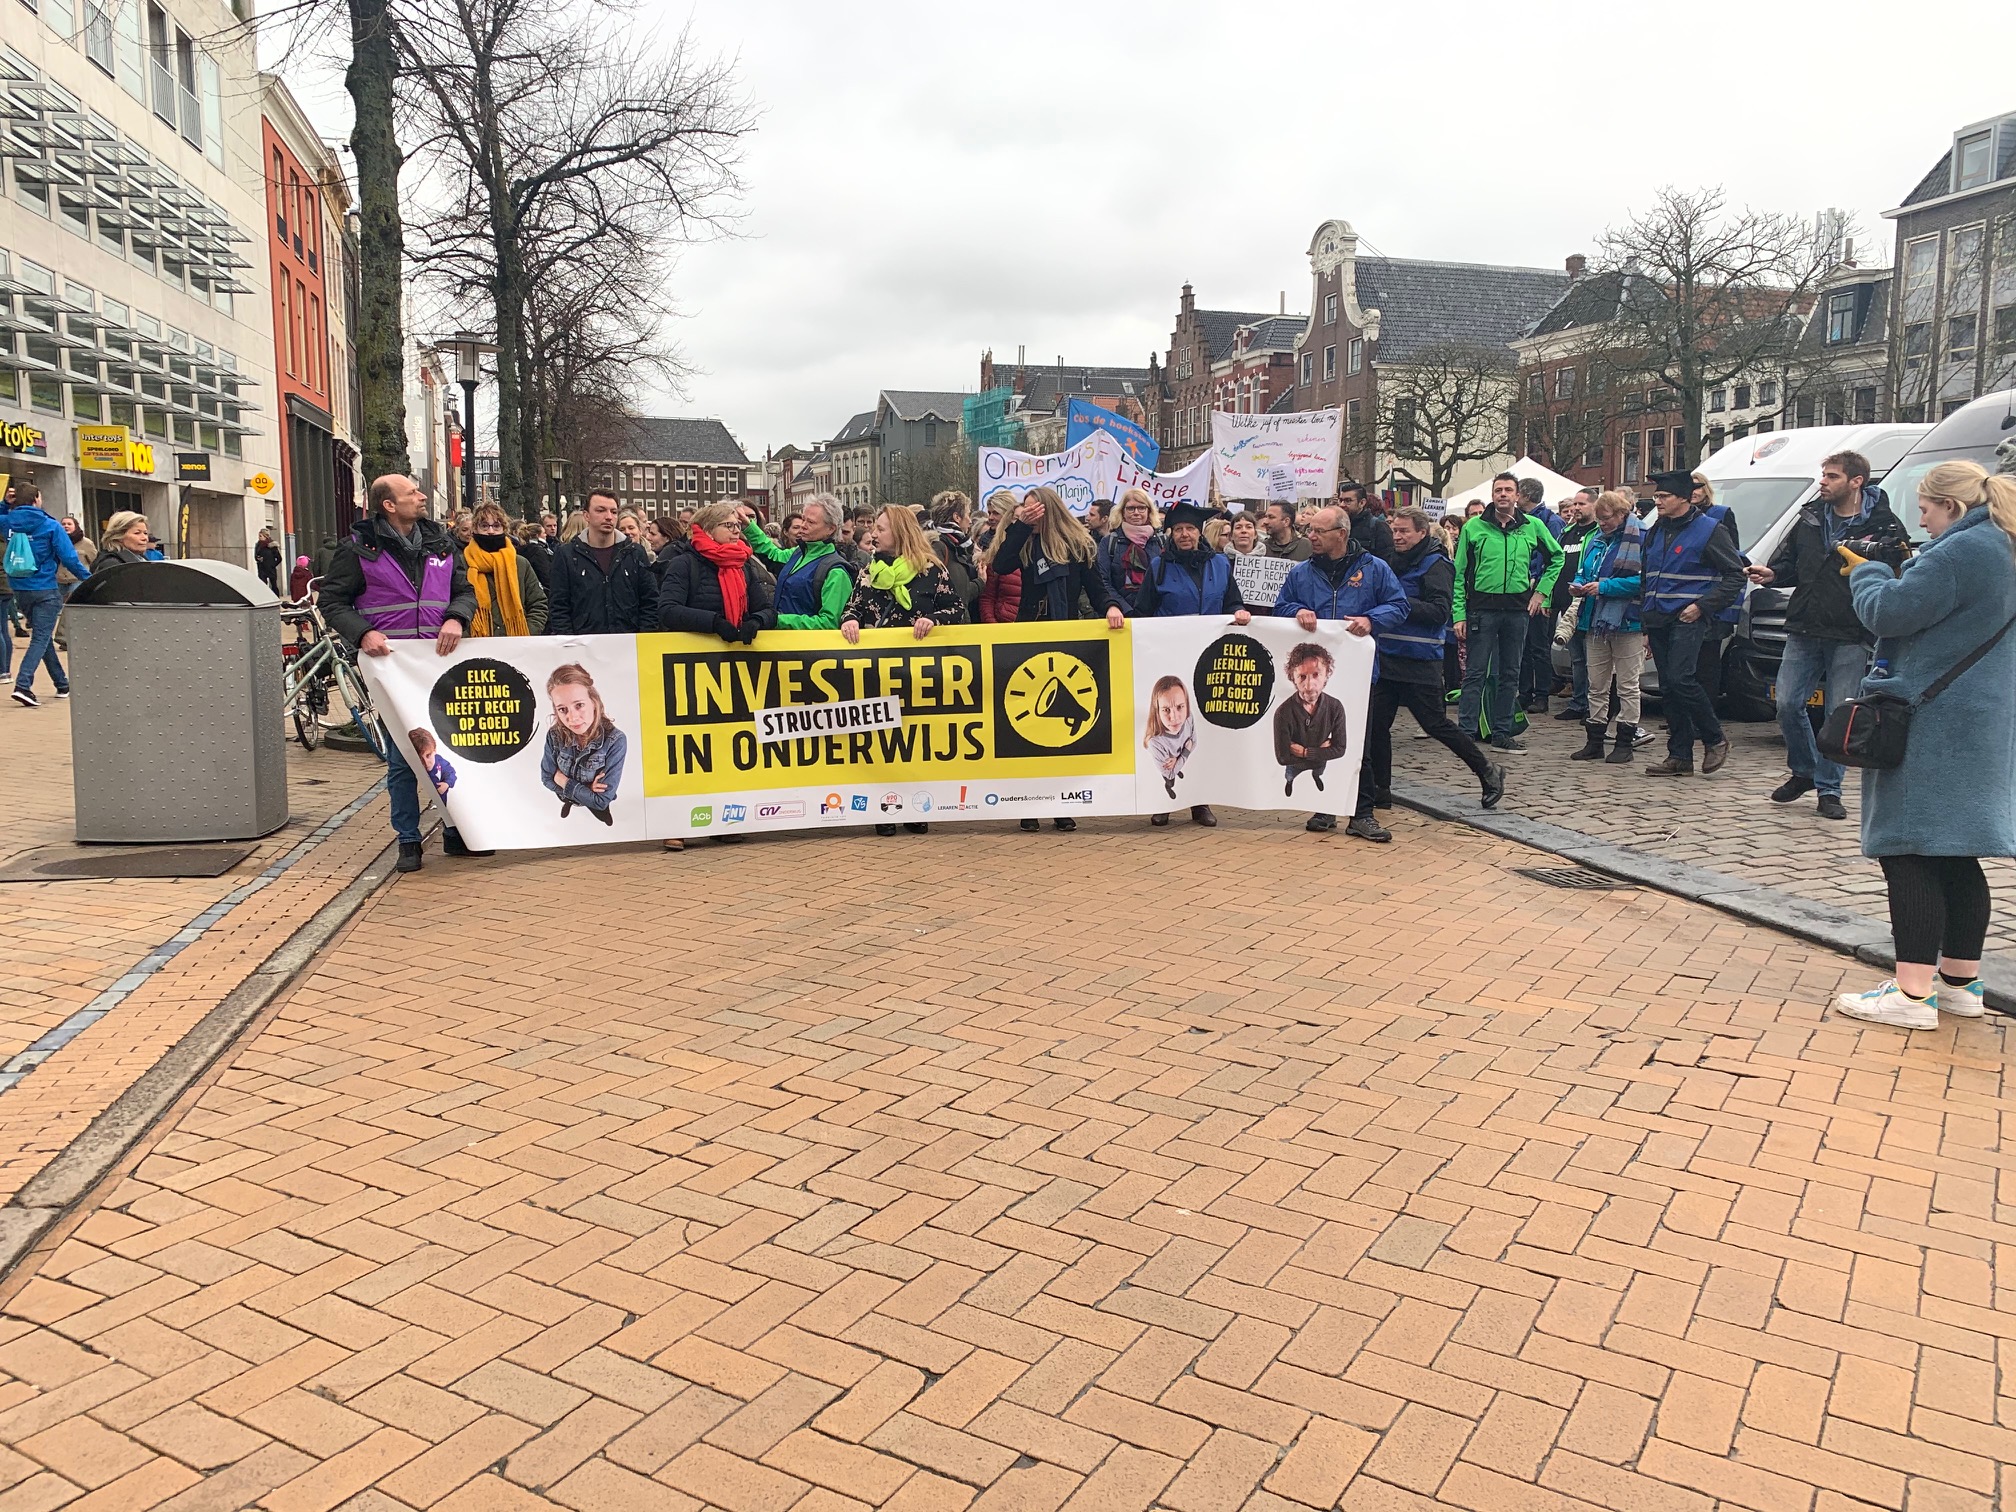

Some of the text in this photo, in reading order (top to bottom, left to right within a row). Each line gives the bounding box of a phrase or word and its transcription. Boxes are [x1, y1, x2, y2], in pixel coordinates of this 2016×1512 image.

[81, 433, 123, 443] Intertoys
[413, 416, 423, 453] Bershka
[129, 441, 154, 475] nos
[985, 442, 1094, 480] Onderwijs
[1116, 464, 1189, 499] Liefde
[1056, 484, 1089, 502] Marijn
[1236, 556, 1260, 568] ELKE
[1235, 567, 1261, 580] HEEFT
[1223, 643, 1248, 657] ELKE
[1213, 657, 1256, 672] LEERLING
[467, 669, 496, 684] ELKE
[1206, 671, 1263, 687] HEEFT RECHT
[454, 684, 511, 700] LEERLING
[672, 655, 976, 717] INVESTEER
[1212, 685, 1254, 700] OP GOED
[445, 699, 521, 716] HEEFT RECHT
[1205, 700, 1260, 715] ONDERWIJS
[459, 715, 510, 731] OP GOED
[762, 701, 895, 736] STRUCTUREEL
[450, 730, 521, 747] ONDERWIJS
[667, 721, 985, 775] IN ONDERWIJS
[1000, 794, 1056, 802] ouders&onderwijs
[1061, 790, 1092, 800] LAKS
[692, 812, 711, 821] AOb
[723, 807, 746, 819] FNV
